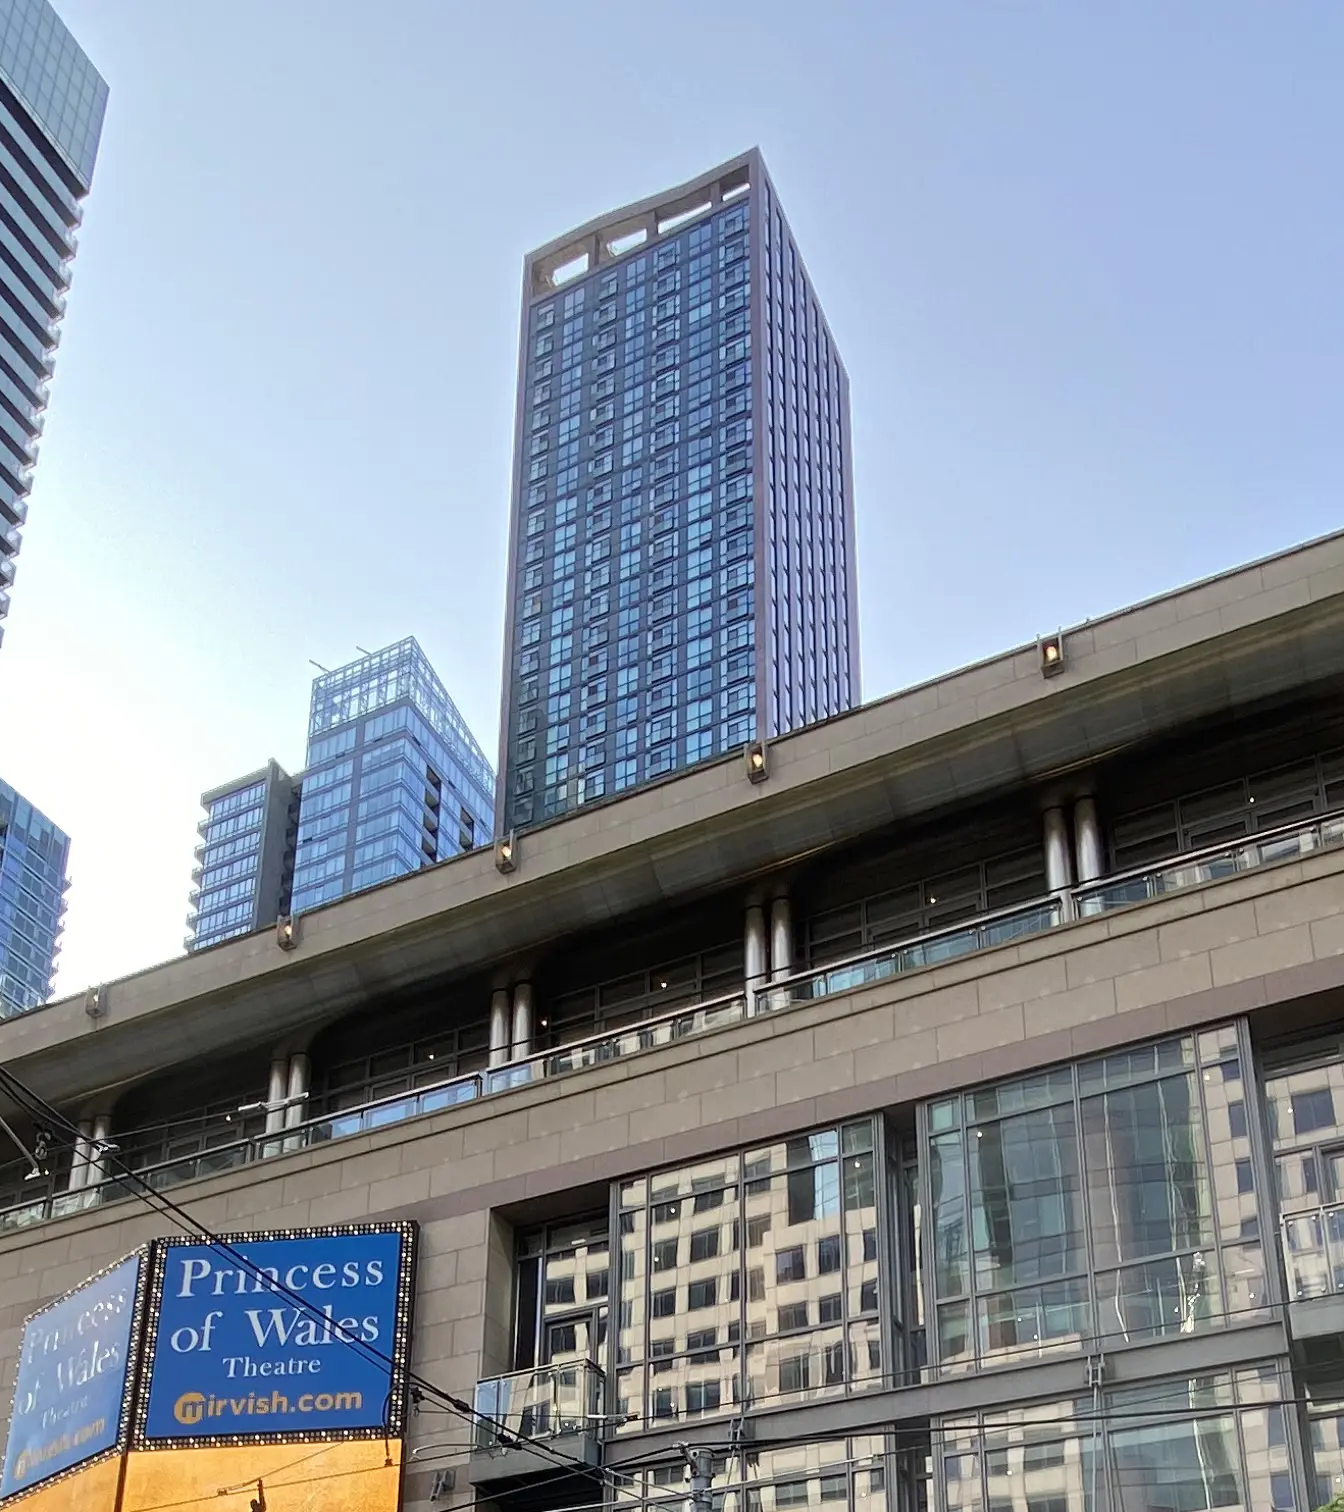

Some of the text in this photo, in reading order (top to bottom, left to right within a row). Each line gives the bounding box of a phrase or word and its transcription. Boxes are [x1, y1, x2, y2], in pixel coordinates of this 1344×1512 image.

[176, 1256, 384, 1298] Princess
[170, 1305, 380, 1353] of Wales
[17, 1340, 120, 1416] of Wales
[223, 1357, 321, 1379] Theatre
[174, 1391, 363, 1425] mirvish.com
